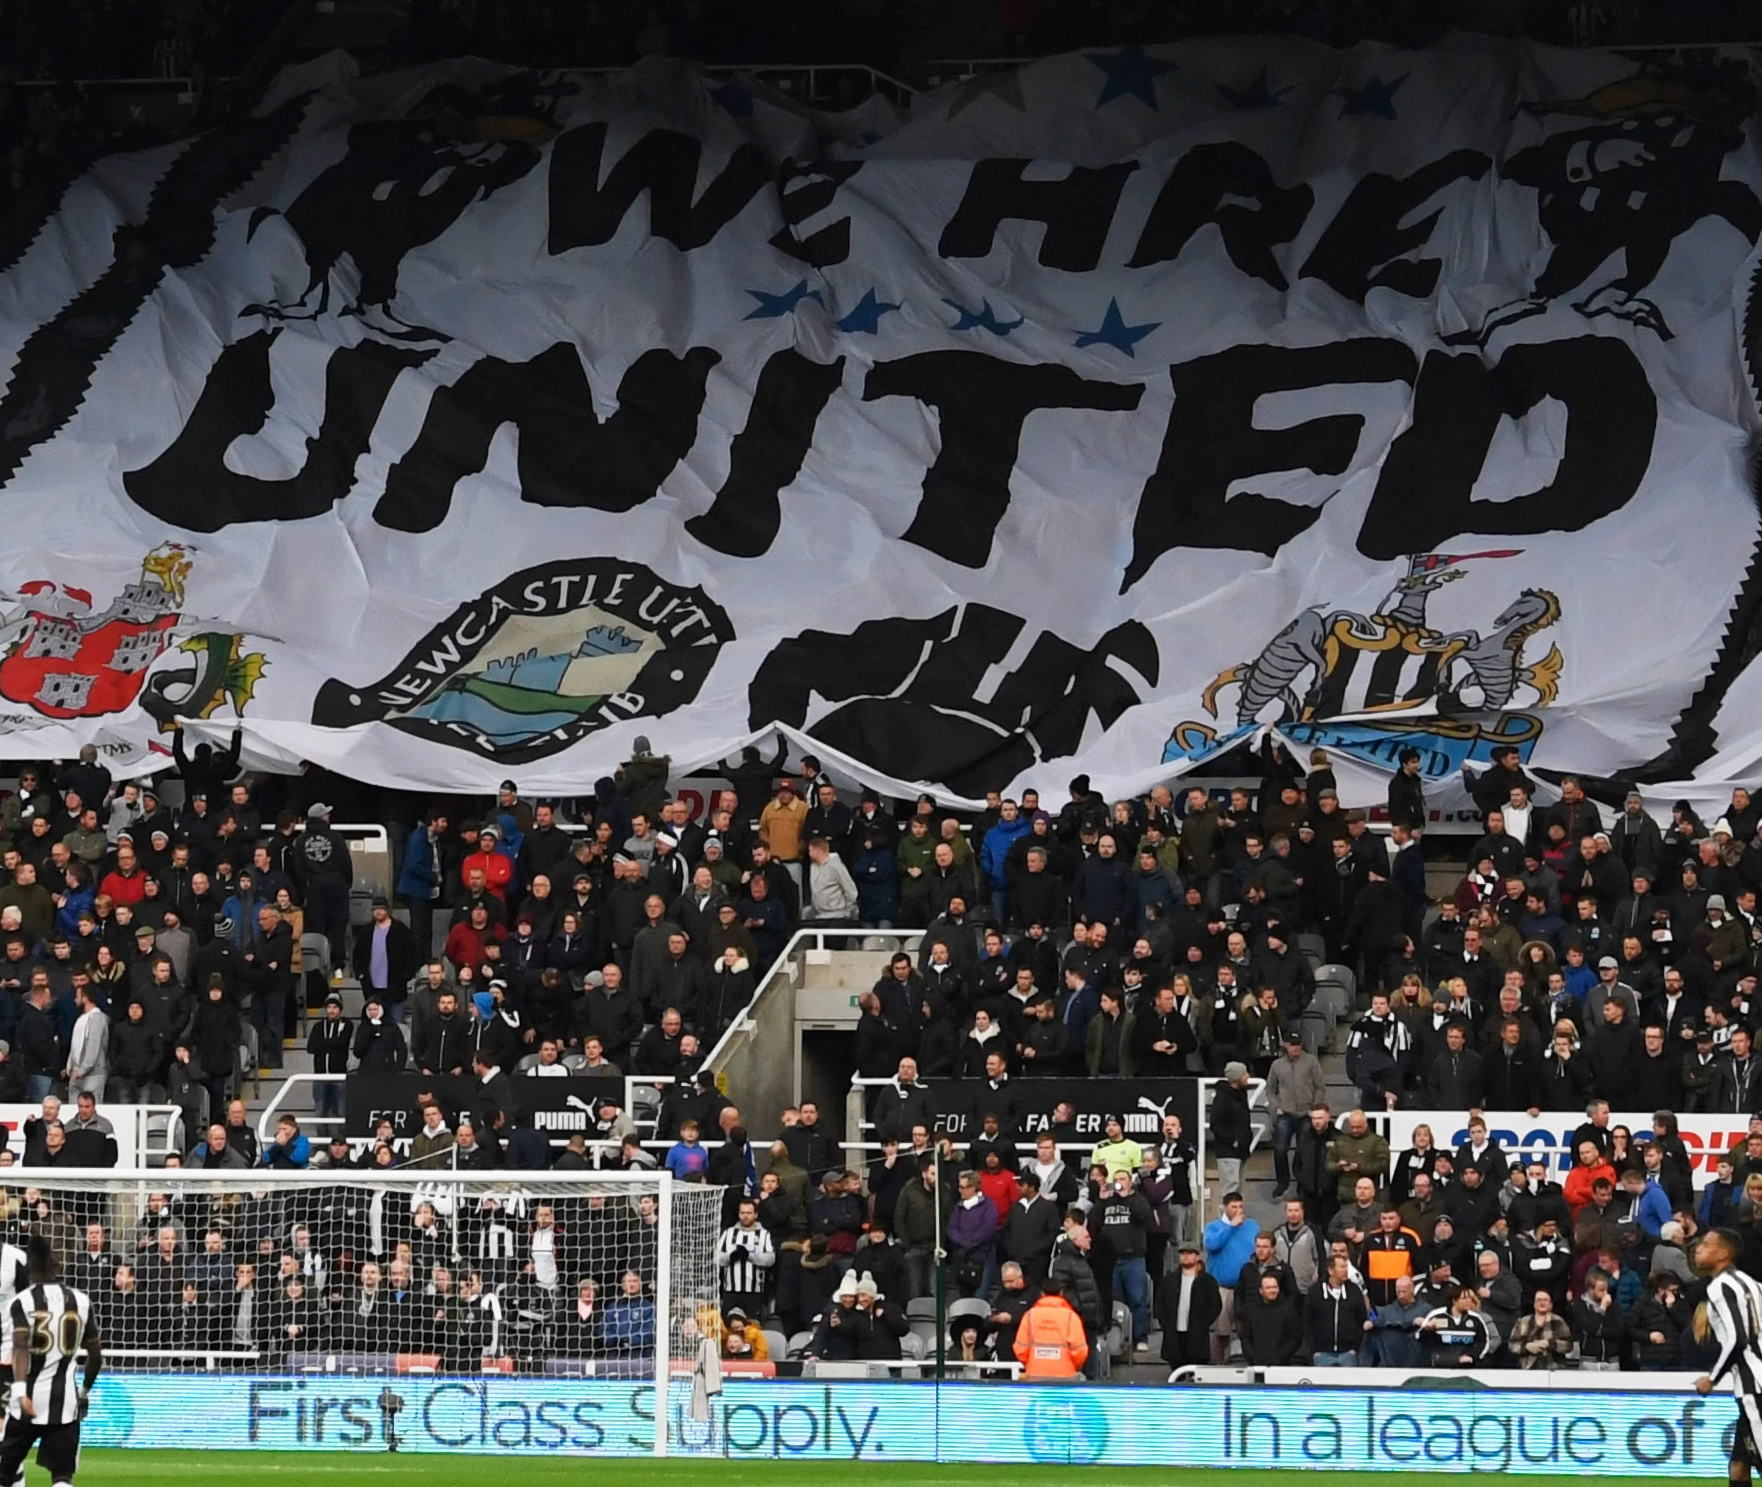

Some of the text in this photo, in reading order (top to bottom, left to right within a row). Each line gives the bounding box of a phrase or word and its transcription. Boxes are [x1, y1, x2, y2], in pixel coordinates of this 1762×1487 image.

[549, 121, 864, 266] WE
[124, 326, 1658, 594] UNITED
[534, 1111, 586, 1131] PUMA
[1026, 1113, 1101, 1133] FAER
[28, 1311, 82, 1356] 30
[248, 1380, 404, 1444] First
[423, 1381, 604, 1448] Class
[1223, 1395, 1281, 1459] In
[1302, 1413, 1342, 1460] a
[1367, 1396, 1606, 1472] league
[1626, 1400, 1705, 1465] of
